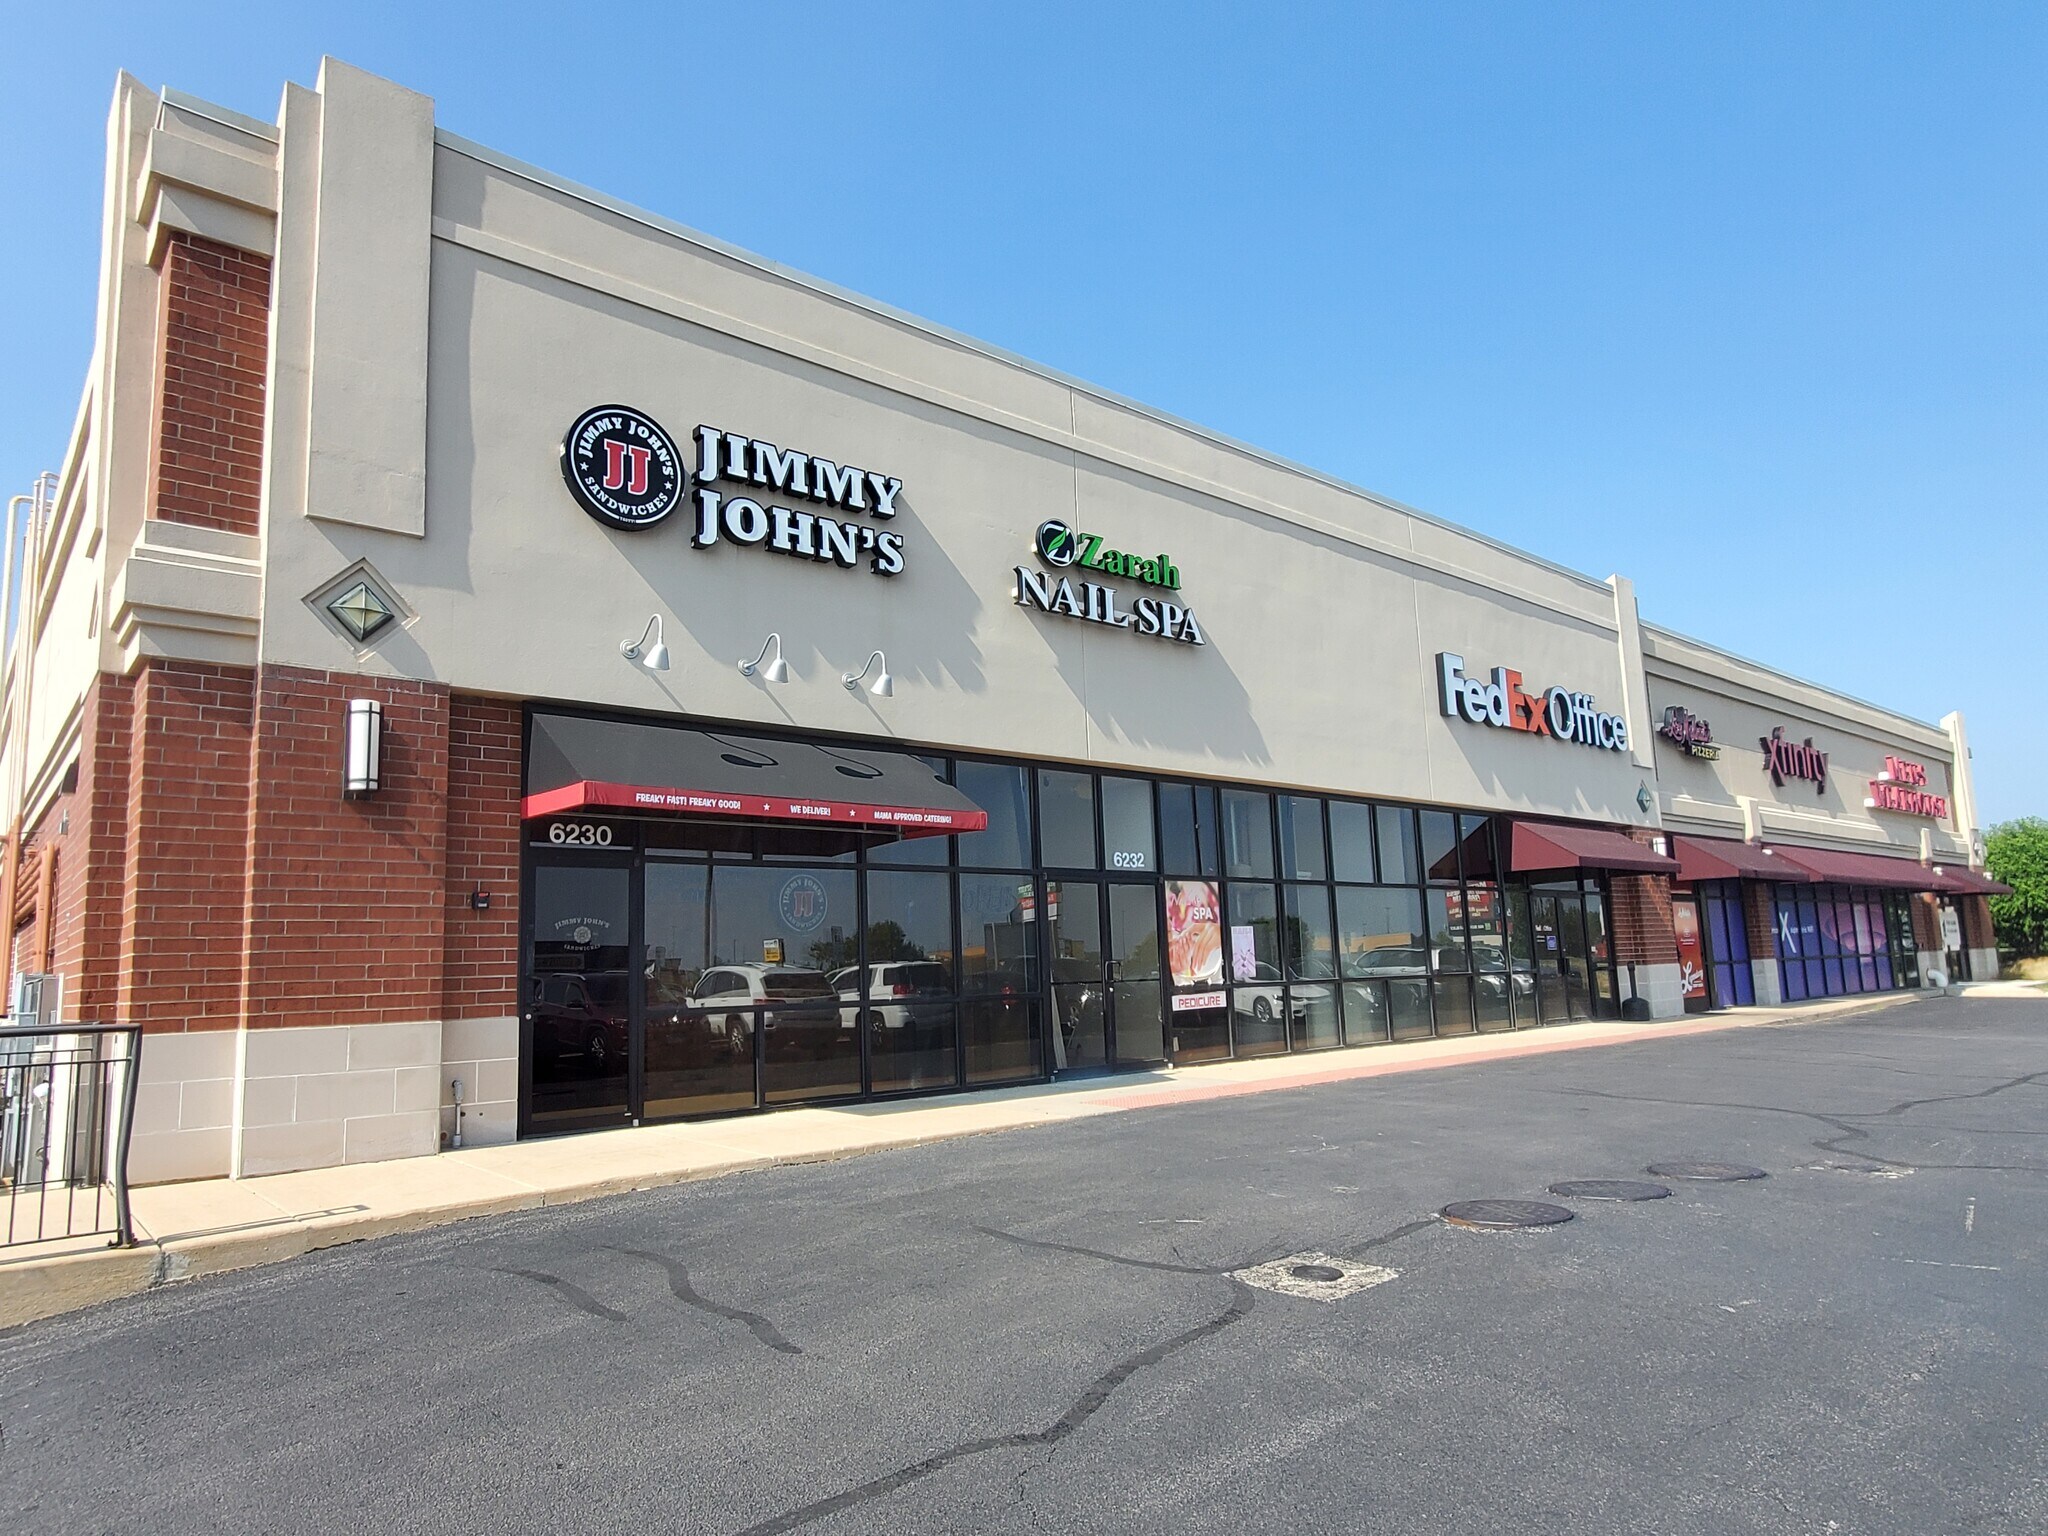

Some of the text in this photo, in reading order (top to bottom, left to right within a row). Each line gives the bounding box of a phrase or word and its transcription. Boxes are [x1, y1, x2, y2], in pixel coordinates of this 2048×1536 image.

[578, 417, 674, 477] JIMMY JOHN'S
[603, 438, 651, 495] JJ
[694, 424, 902, 519] JIMMY
[585, 476, 668, 515] SANDWICHES
[694, 488, 905, 576] JOHN'S
[1078, 532, 1181, 590] Zarah
[1013, 565, 1206, 645] NAIL SPA
[1436, 652, 1629, 751] FedEx Office
[635, 793, 741, 809] FREAKY FAST! FREAKY GOOD!
[790, 804, 831, 816] WE DELIVER!
[874, 811, 952, 823] MAMA APPROVED CATERING!
[549, 822, 612, 846] 6230
[1113, 851, 1145, 868] 6232
[554, 917, 610, 930] JIMMY JOHN'S
[1193, 907, 1214, 920] SPA
[1178, 995, 1221, 1009] PEDICURE
